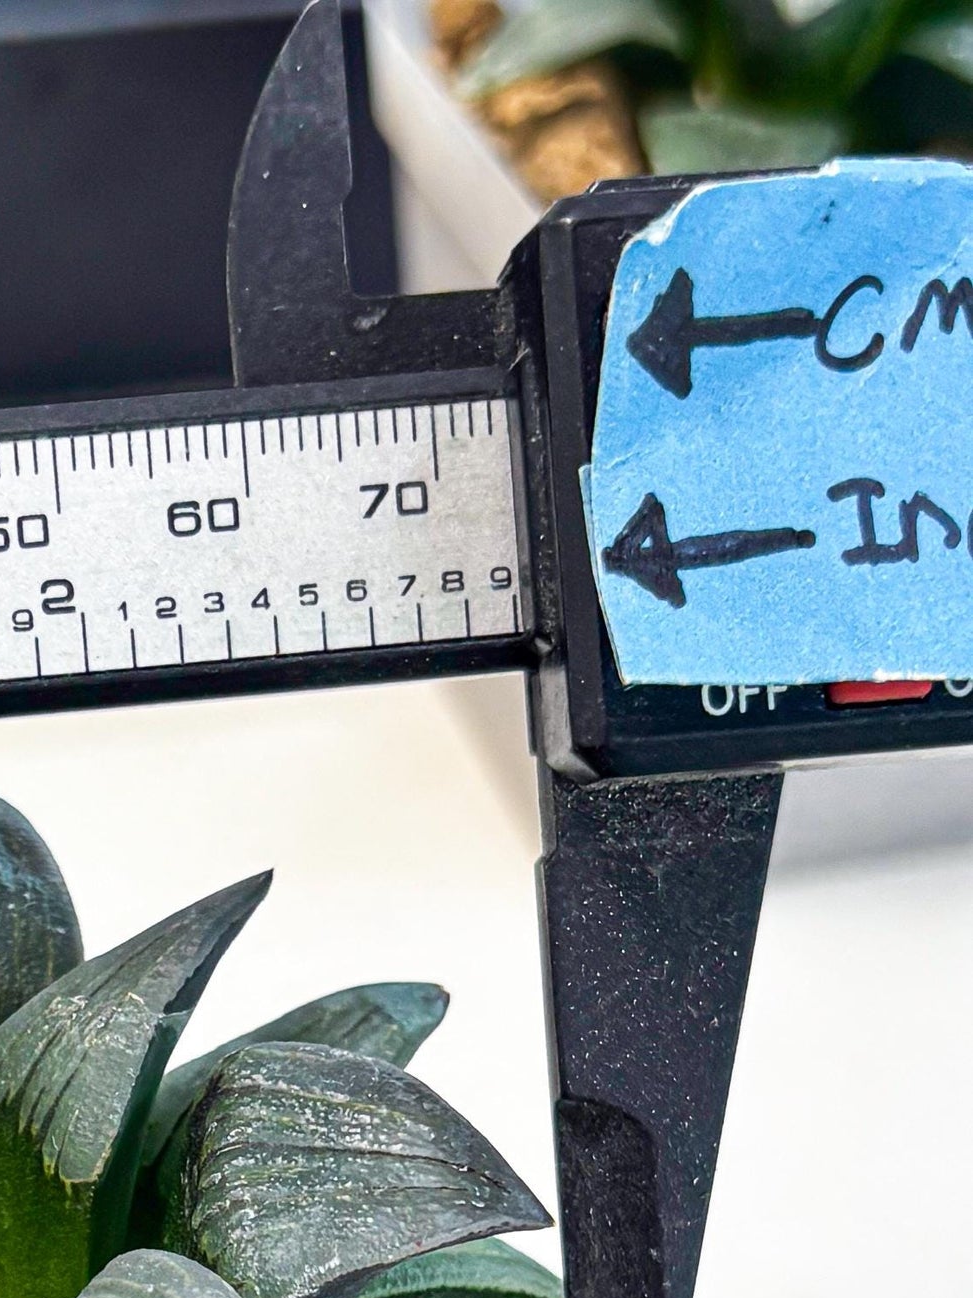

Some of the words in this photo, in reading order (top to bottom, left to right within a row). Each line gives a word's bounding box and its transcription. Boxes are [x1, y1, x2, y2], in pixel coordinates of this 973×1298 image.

[167, 498, 240, 537] 60
[359, 481, 429, 519] 70
[11, 609, 34, 632] 9
[40, 578, 76, 615] 2
[118, 601, 128, 621] 1
[155, 596, 177, 619] 2
[203, 591, 225, 613] 3
[251, 587, 271, 610] 4
[298, 583, 319, 606] 5
[346, 579, 368, 602] 6
[398, 575, 417, 597] 7
[441, 570, 465, 593] 8
[489, 566, 513, 591] 9
